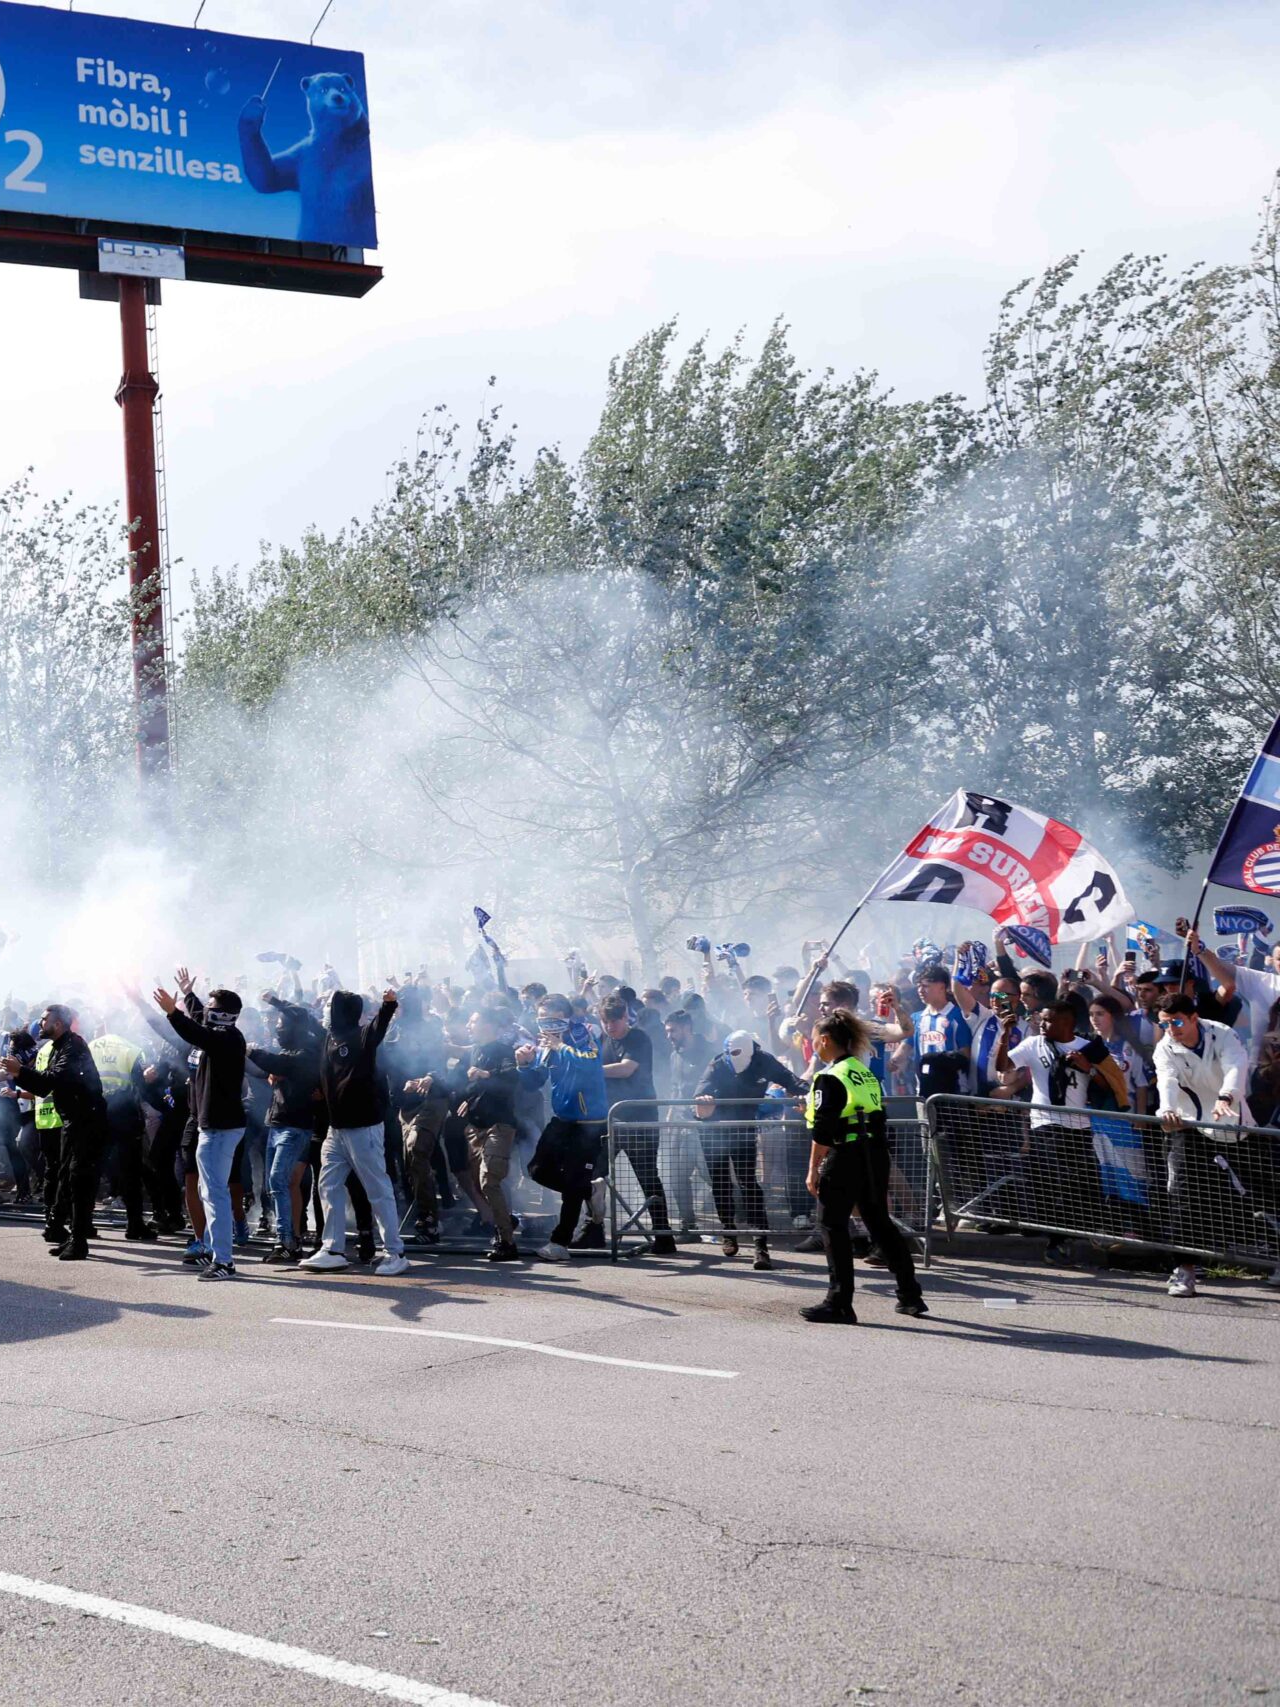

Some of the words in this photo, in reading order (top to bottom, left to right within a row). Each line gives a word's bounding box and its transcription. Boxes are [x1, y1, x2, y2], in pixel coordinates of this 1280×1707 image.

[76, 57, 171, 102] Fibra,
[79, 99, 172, 135] mòbil
[178, 110, 188, 137] i
[79, 142, 243, 184] senzillesa
[1245, 847, 1266, 868] CLUB
